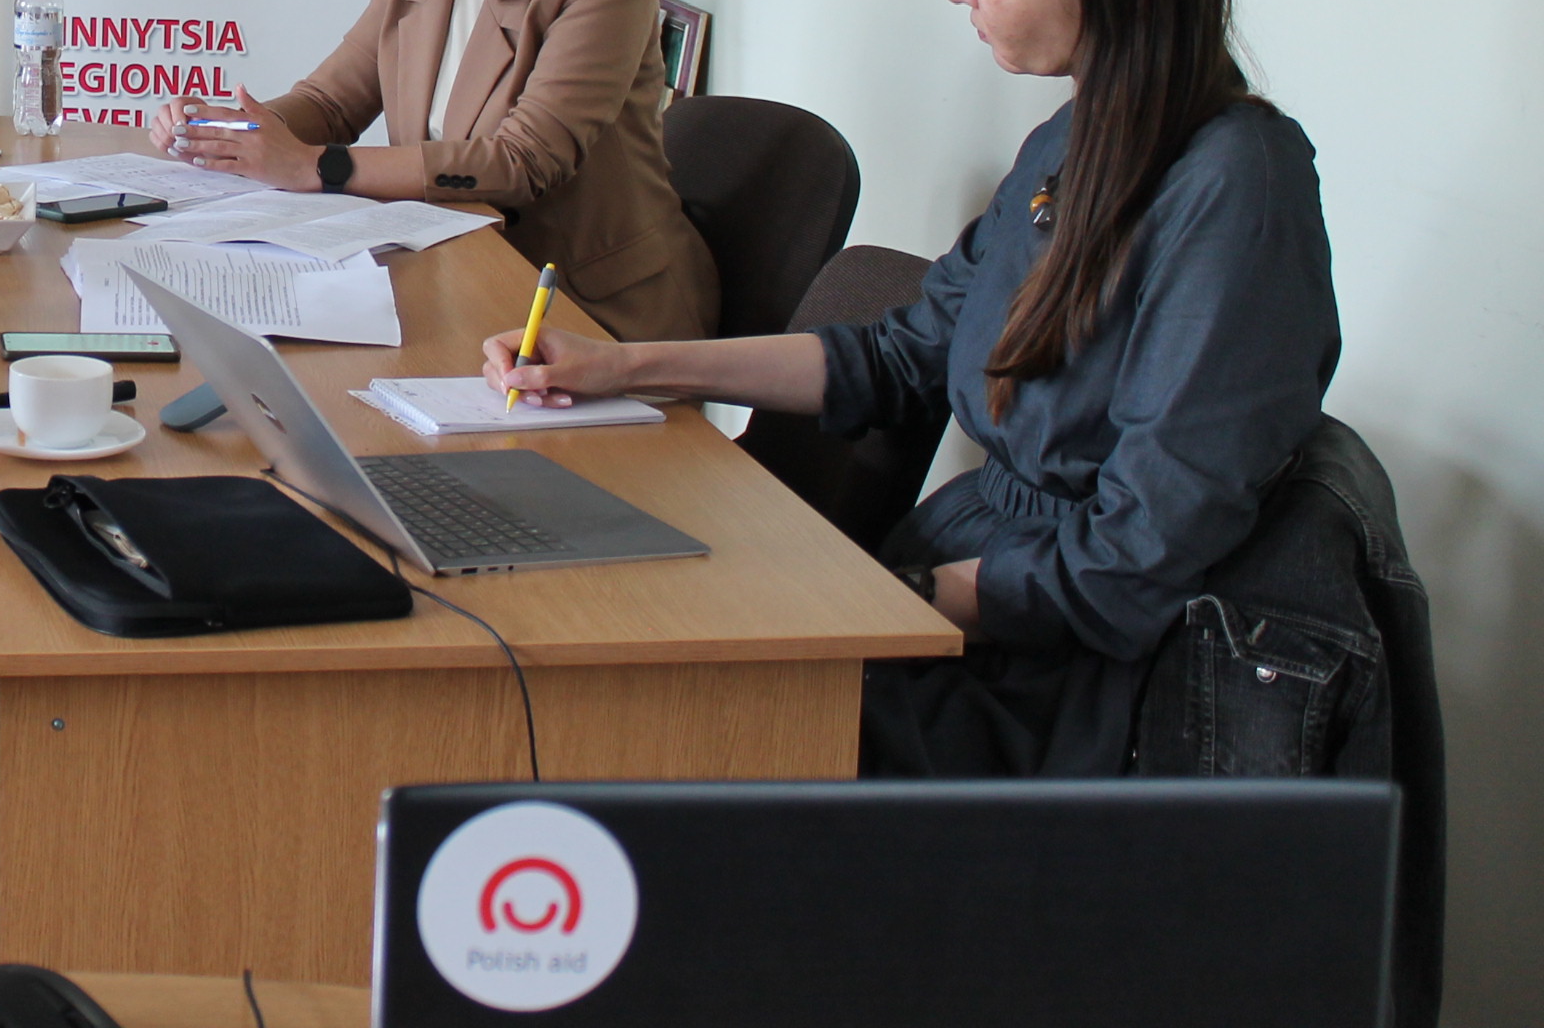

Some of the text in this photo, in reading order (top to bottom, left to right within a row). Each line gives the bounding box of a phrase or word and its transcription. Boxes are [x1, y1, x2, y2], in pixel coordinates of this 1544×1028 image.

[62, 16, 244, 52] INNYTSIA
[59, 62, 234, 97] EGIONAL
[467, 949, 588, 973] Polish aid
